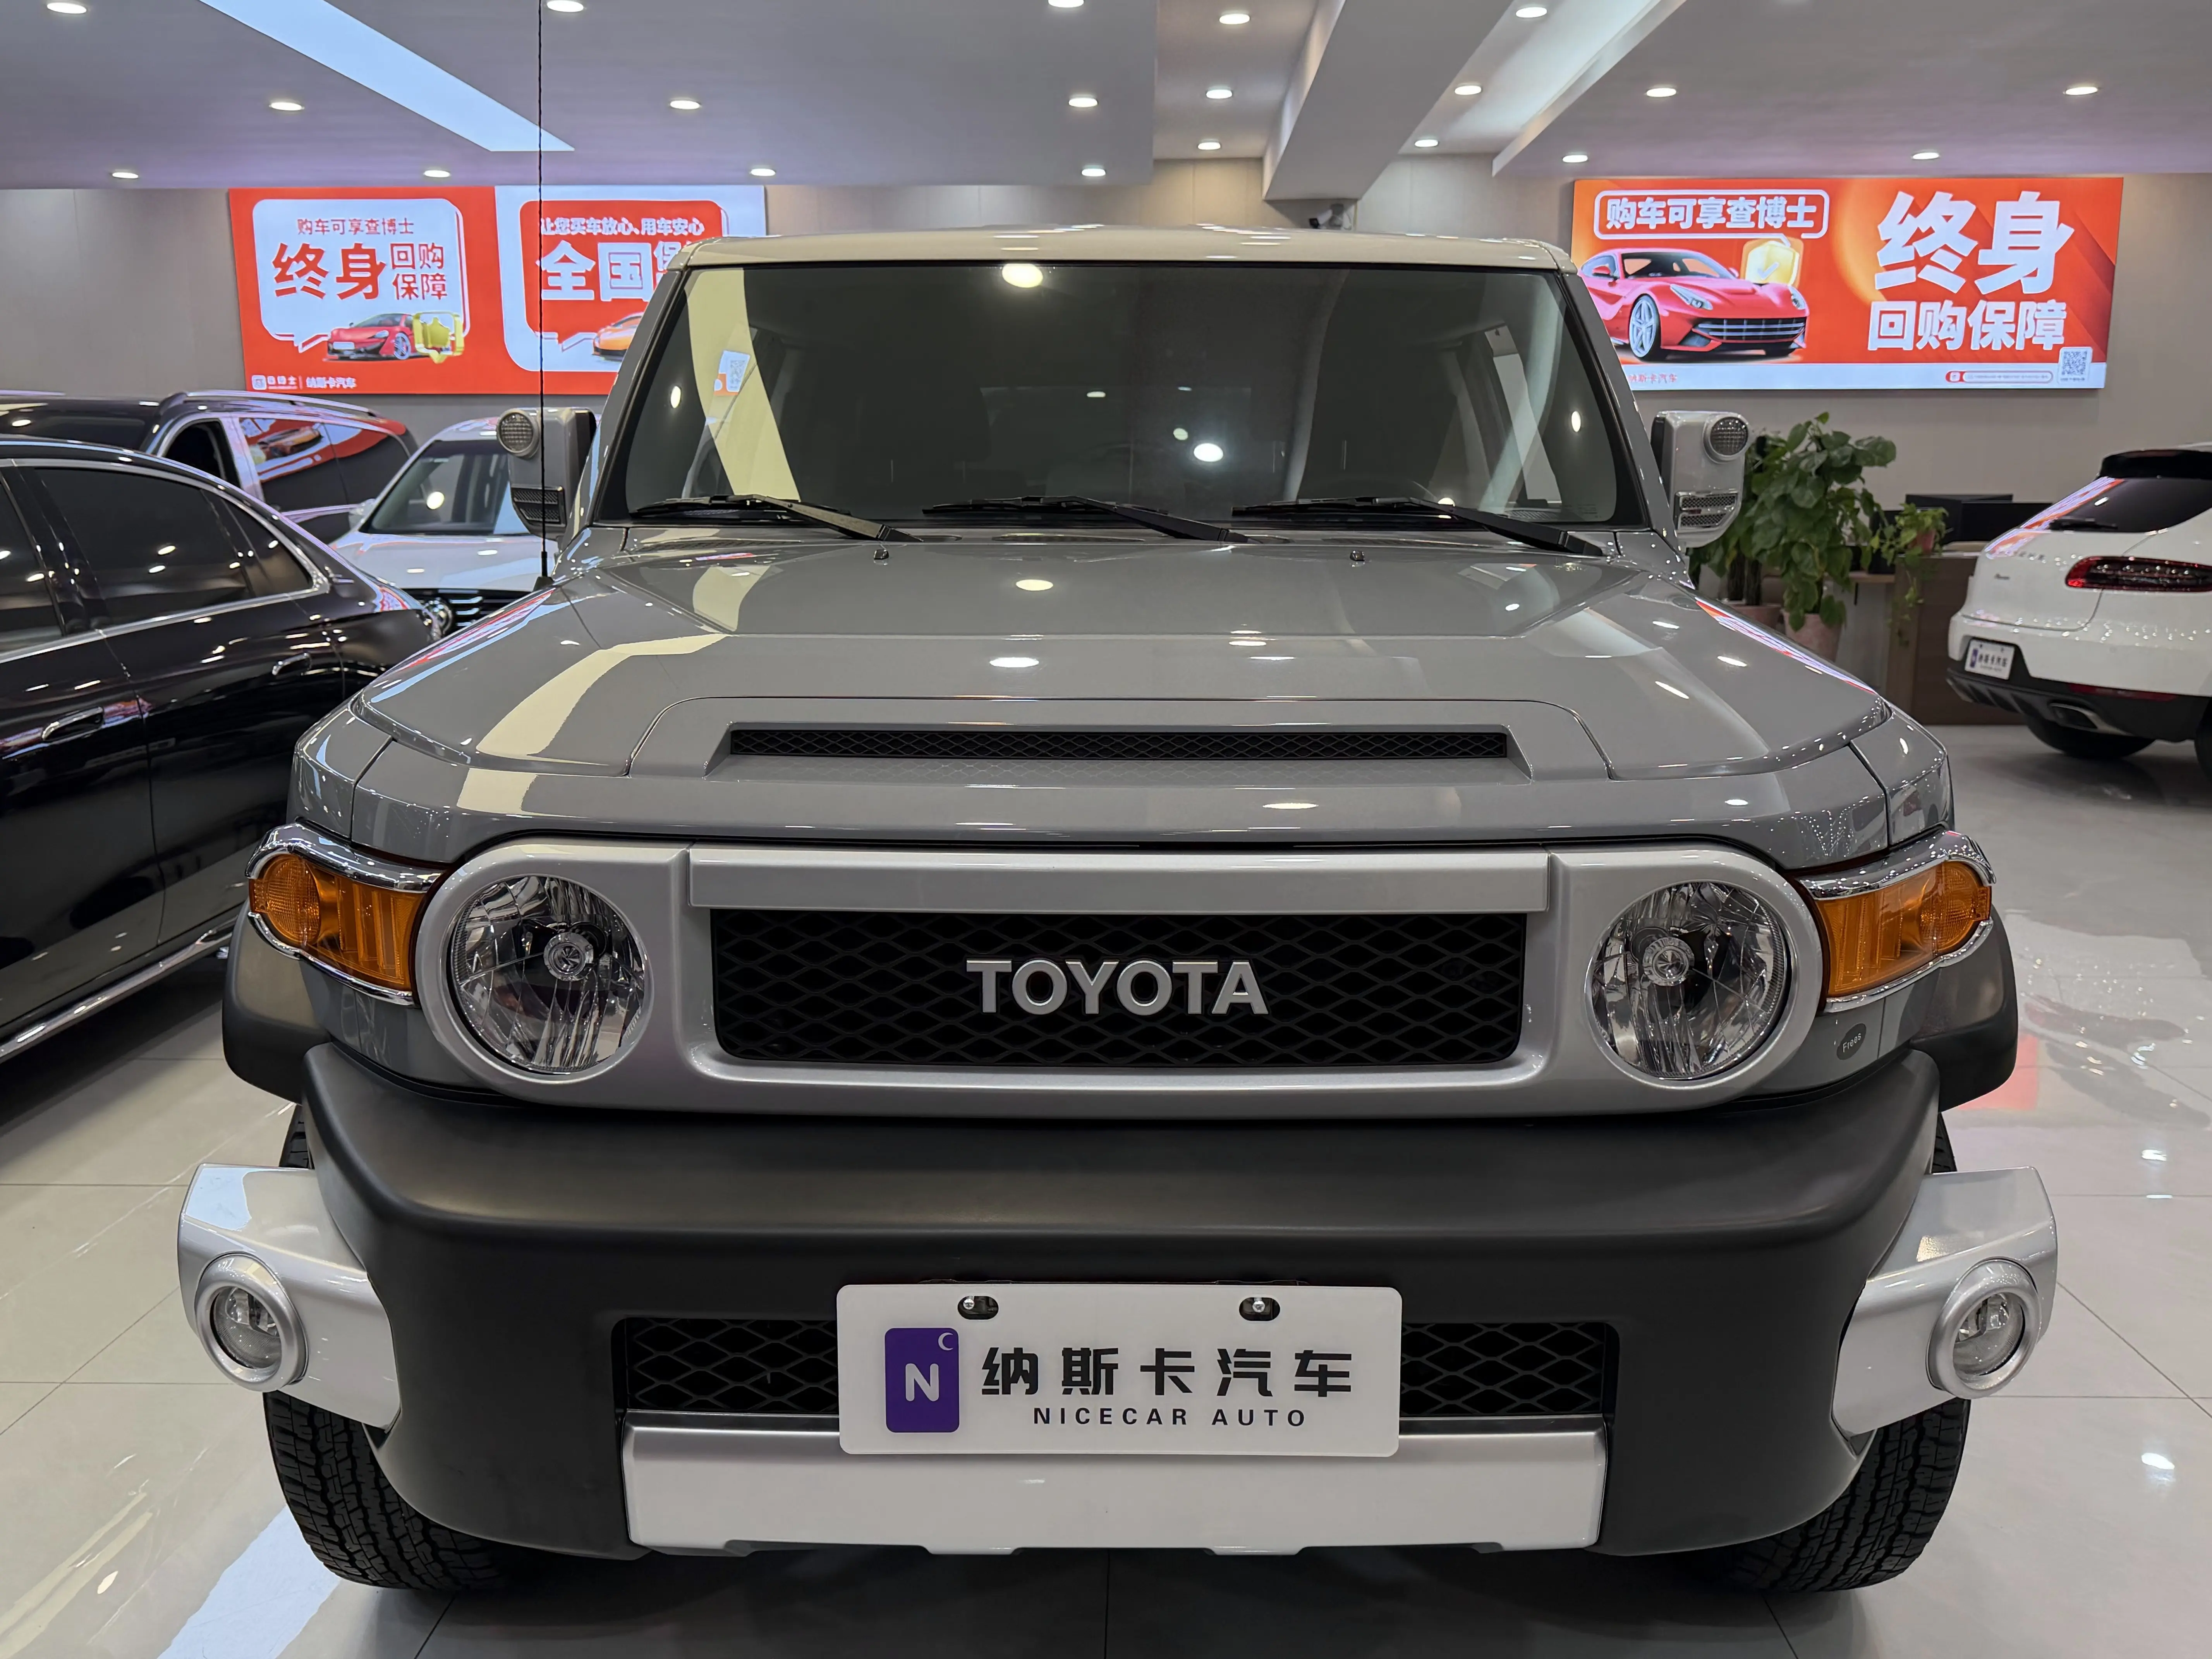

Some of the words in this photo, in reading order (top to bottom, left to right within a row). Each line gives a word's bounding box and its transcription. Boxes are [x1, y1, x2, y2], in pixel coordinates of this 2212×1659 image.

[297, 218, 414, 235] 购车可享查博士
[1606, 196, 1817, 229] 购车可享查博士
[390, 242, 444, 270] 回购
[1874, 191, 2075, 295] 终身
[272, 242, 386, 300] 终身
[392, 273, 448, 300] 保障
[536, 240, 654, 301] 全国
[1867, 299, 2067, 351] 回购保障
[966, 959, 1269, 1016] TOYOTA
[1843, 1033, 1861, 1053] Frees
[905, 1363, 939, 1402] N
[981, 1346, 1353, 1398] 纳斯卡汽车
[1034, 1407, 1187, 1426] NICECAR
[1211, 1409, 1305, 1427] AUTO
